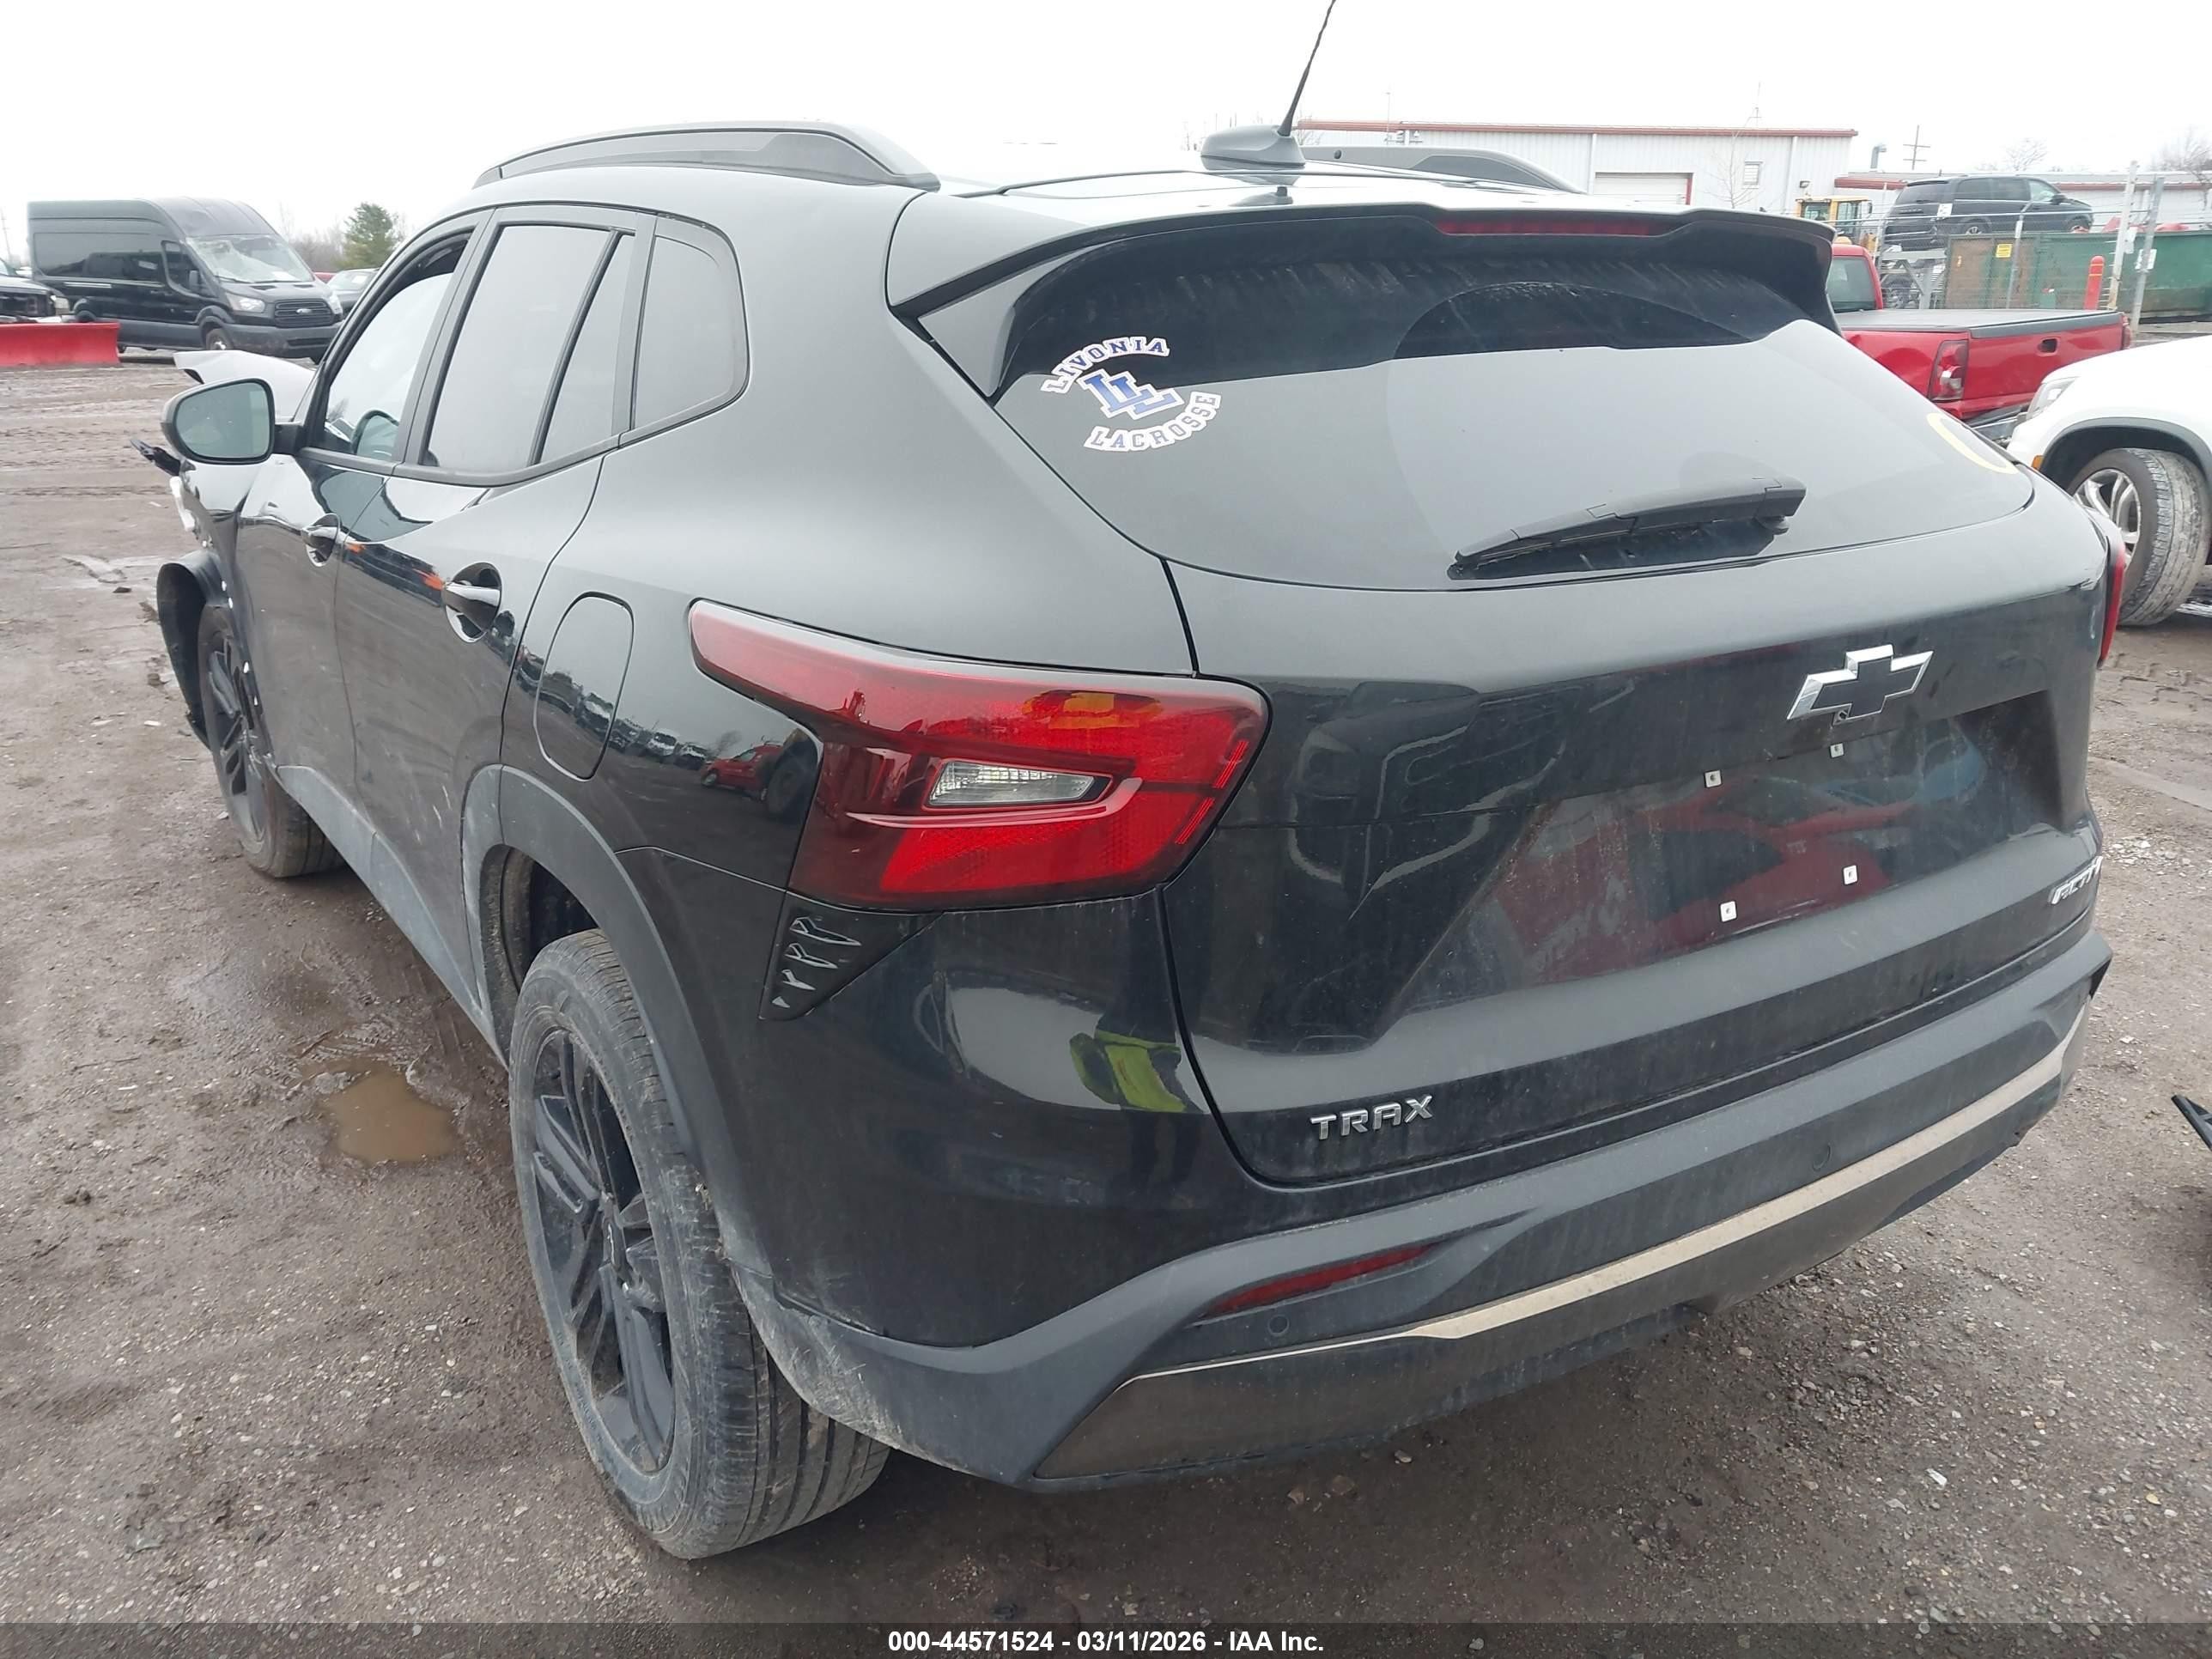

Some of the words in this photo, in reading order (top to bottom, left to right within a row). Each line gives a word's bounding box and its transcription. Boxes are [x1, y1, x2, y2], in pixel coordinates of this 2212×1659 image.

[1043, 337, 1168, 393] LIVONIA
[1079, 371, 1182, 418] LL
[1086, 393, 1219, 450] LACROSSE
[1310, 1094, 1433, 1140] TRAX
